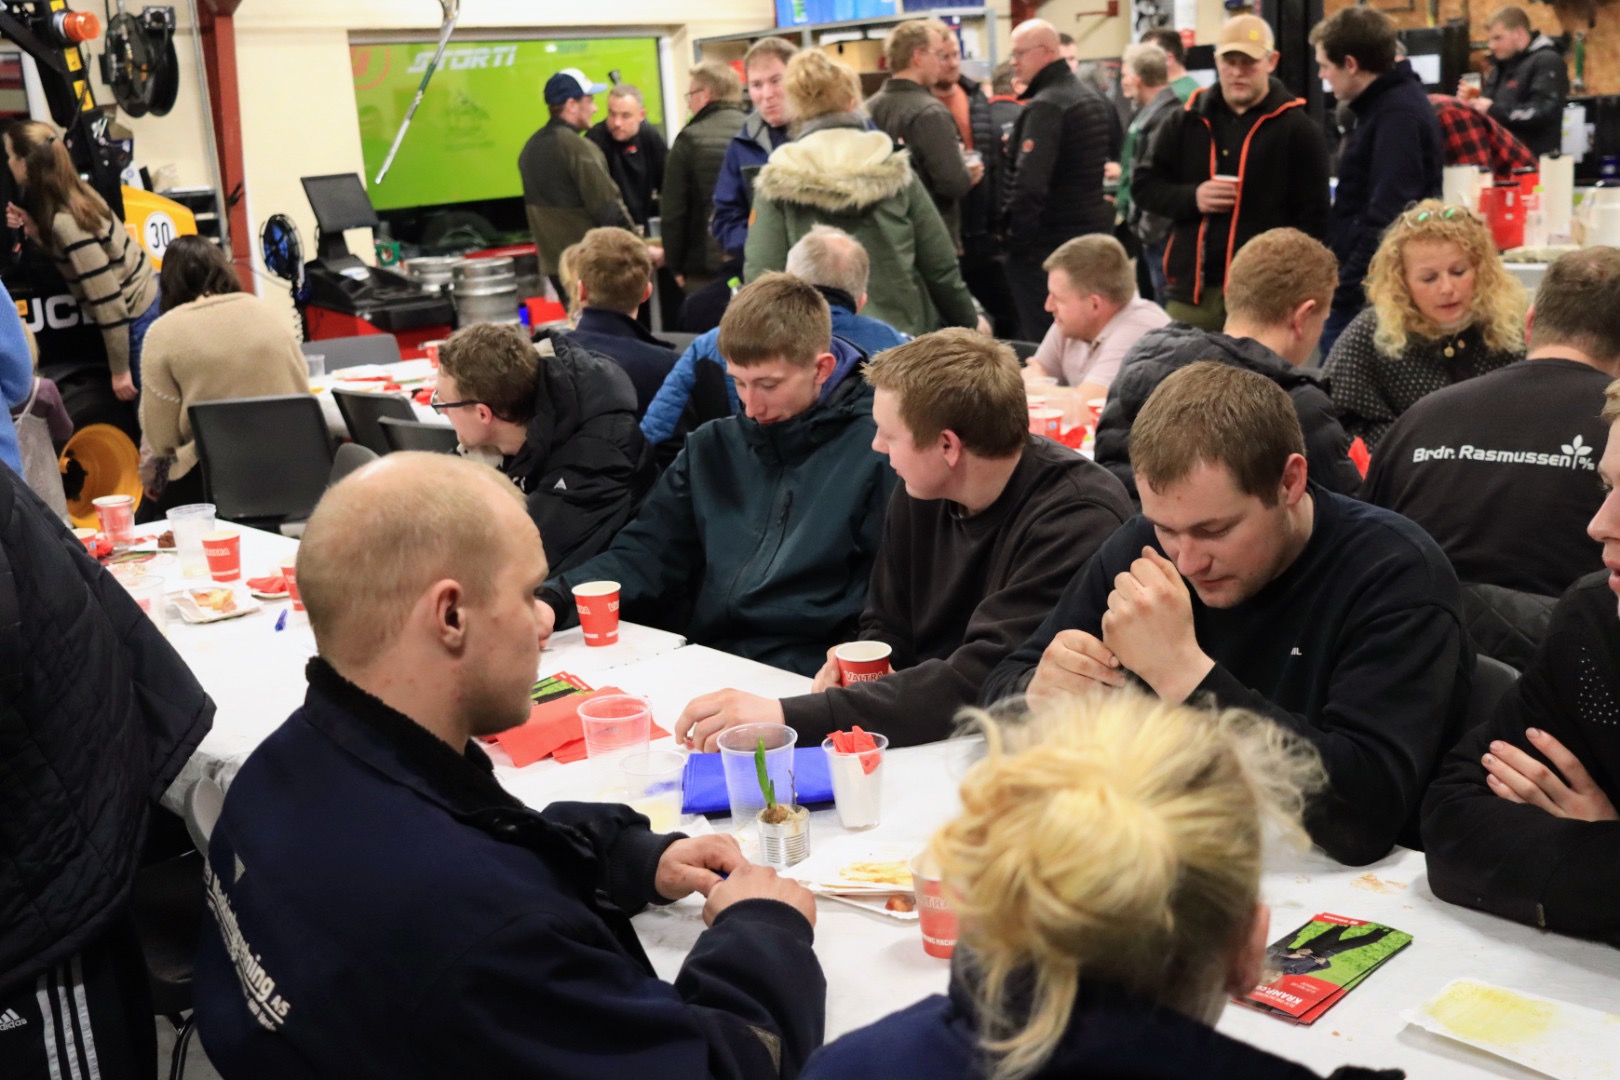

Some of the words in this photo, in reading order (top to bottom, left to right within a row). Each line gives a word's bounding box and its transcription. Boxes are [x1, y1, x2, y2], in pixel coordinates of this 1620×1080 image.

[407, 44, 519, 74] STORTI
[150, 221, 171, 249] 30
[26, 294, 97, 334] JC
[1412, 445, 1456, 463] Brdr.
[1458, 445, 1571, 468] Rasmussen
